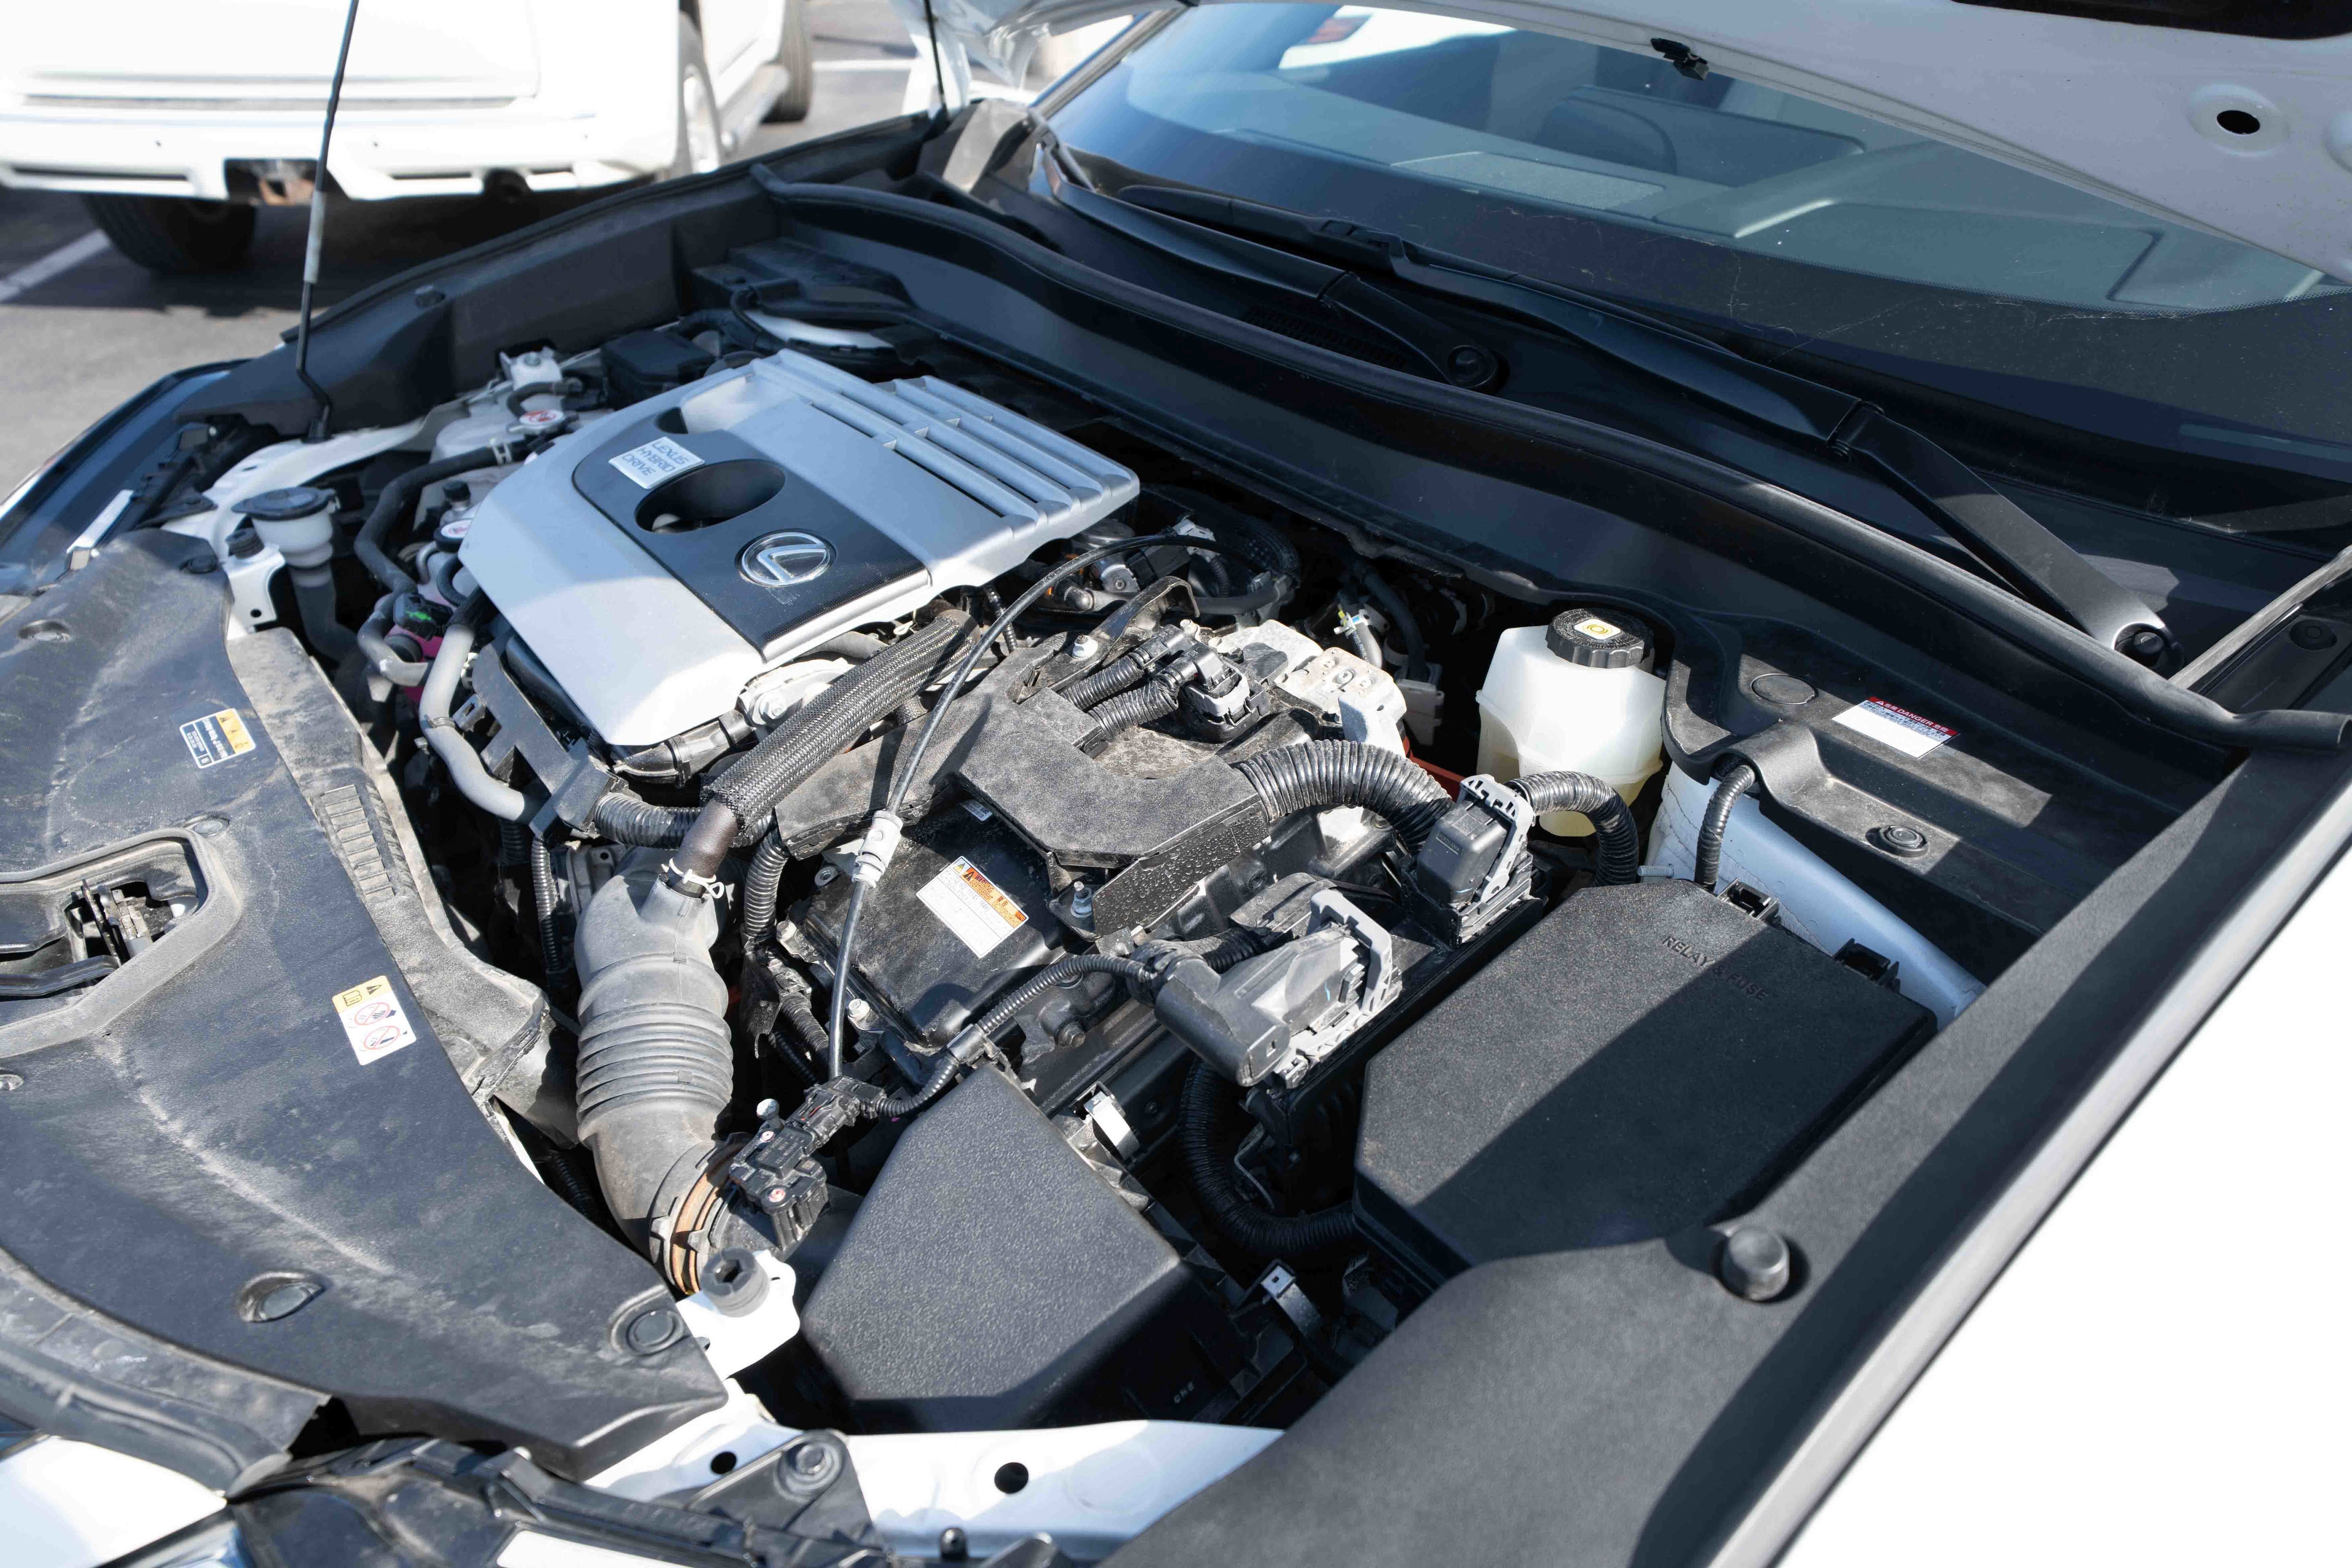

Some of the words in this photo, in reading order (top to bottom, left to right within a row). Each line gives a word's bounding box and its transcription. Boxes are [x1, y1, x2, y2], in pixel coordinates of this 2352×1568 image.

[636, 448, 675, 472] HYBRID
[653, 441, 689, 465] LEXUS
[622, 454, 656, 476] DRIVE
[1897, 709, 1933, 726] DANGER
[974, 874, 994, 893] WARNING
[1662, 936, 1715, 967] RELAY
[1727, 973, 1768, 1000] FUSE
